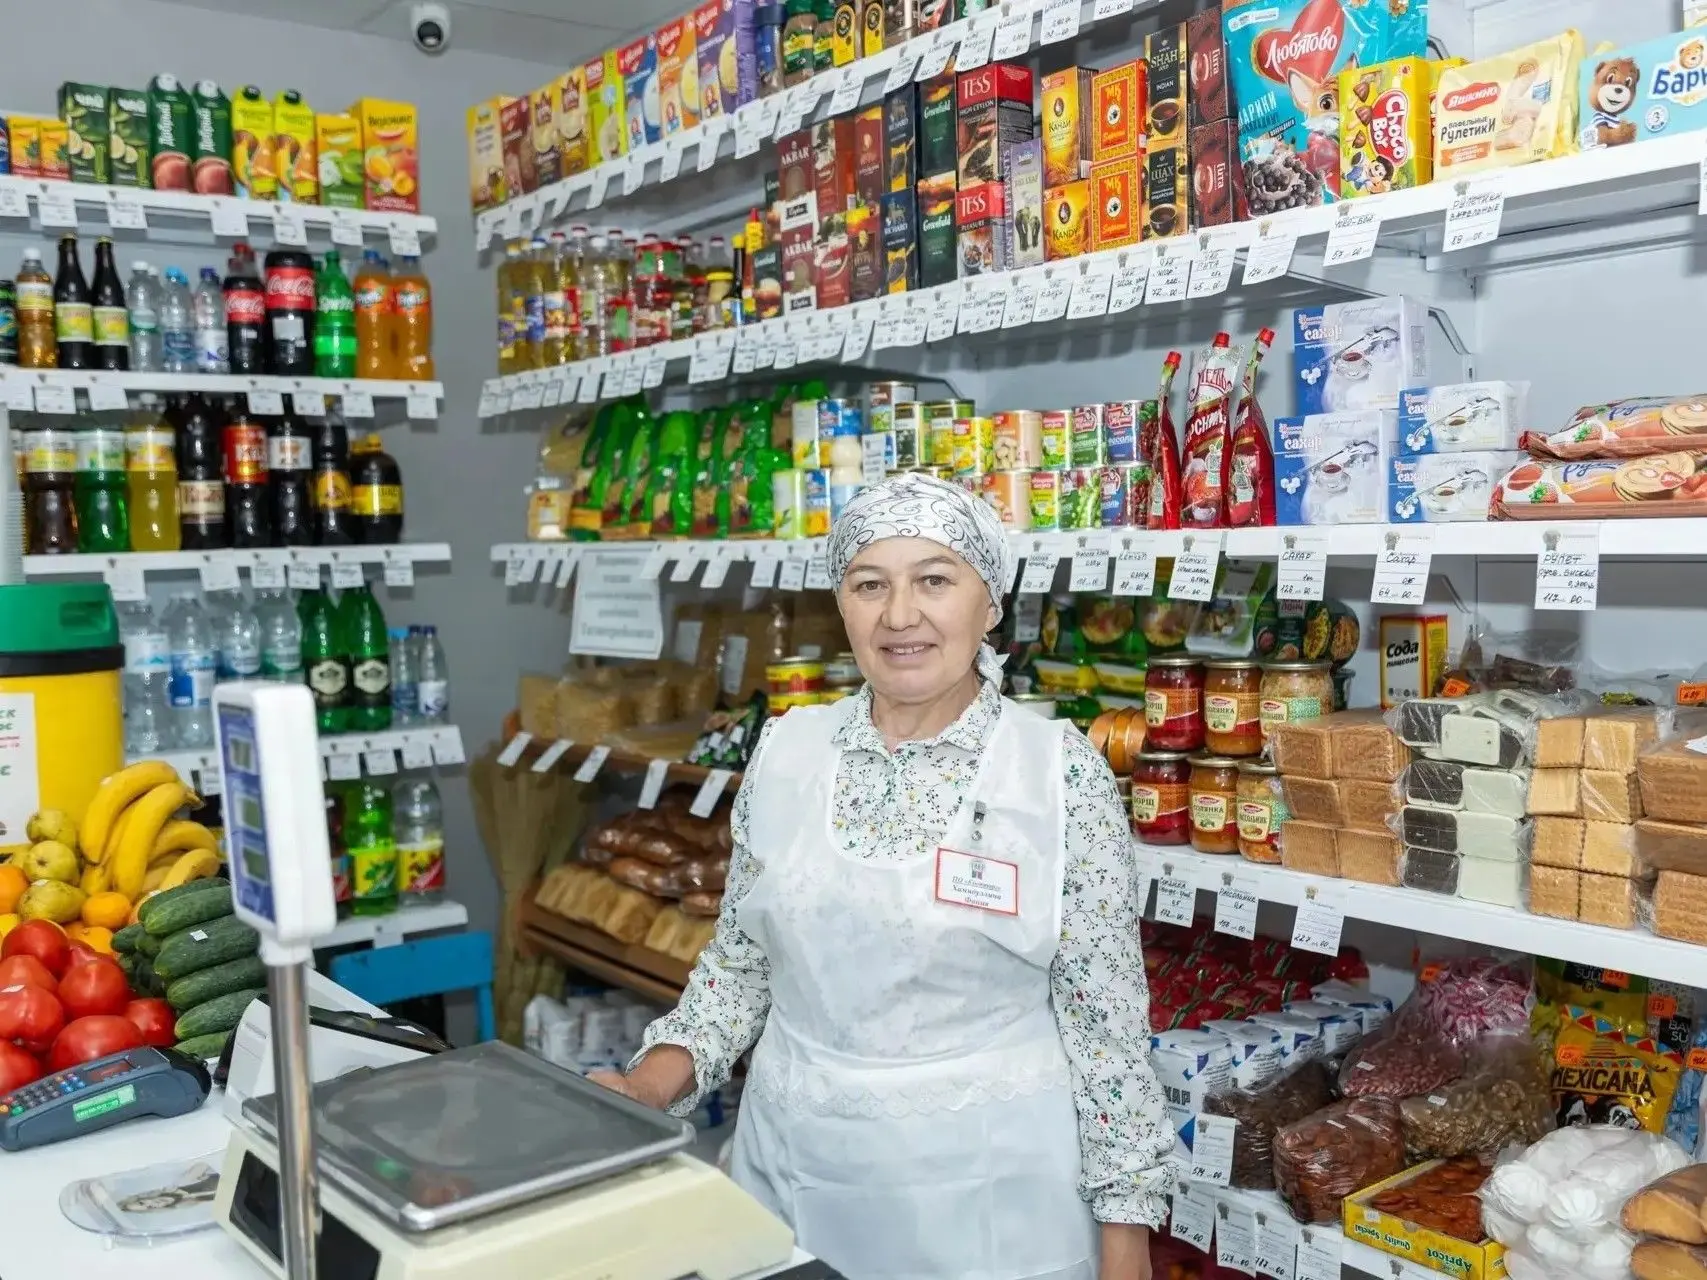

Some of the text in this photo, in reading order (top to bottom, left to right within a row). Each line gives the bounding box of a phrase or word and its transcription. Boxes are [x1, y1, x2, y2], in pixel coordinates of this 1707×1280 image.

[1265, 26, 1338, 72] Любятово
[1151, 49, 1178, 69] SHAH
[962, 72, 991, 99] TESS
[1156, 81, 1174, 91] INDIAN
[1448, 86, 1499, 108] Яшкино
[1385, 94, 1406, 159] Choco
[781, 147, 809, 166] AKBAR
[960, 192, 986, 217] TESS
[1052, 225, 1079, 240] KANDY
[785, 240, 813, 257] AKBAR
[1304, 325, 1343, 342] сахар
[1407, 402, 1441, 416] сахар
[1284, 434, 1323, 451] сахар
[1397, 469, 1430, 484] сахар
[1282, 552, 1312, 561] САХАР
[1386, 552, 1417, 567] Сахар
[1544, 554, 1581, 565] РУЛЕТ
[1386, 640, 1419, 658] Сода
[1552, 1067, 1657, 1098] MEXICANA
[1354, 1223, 1411, 1251] Quality Special
[1426, 1247, 1473, 1272] Apricot
